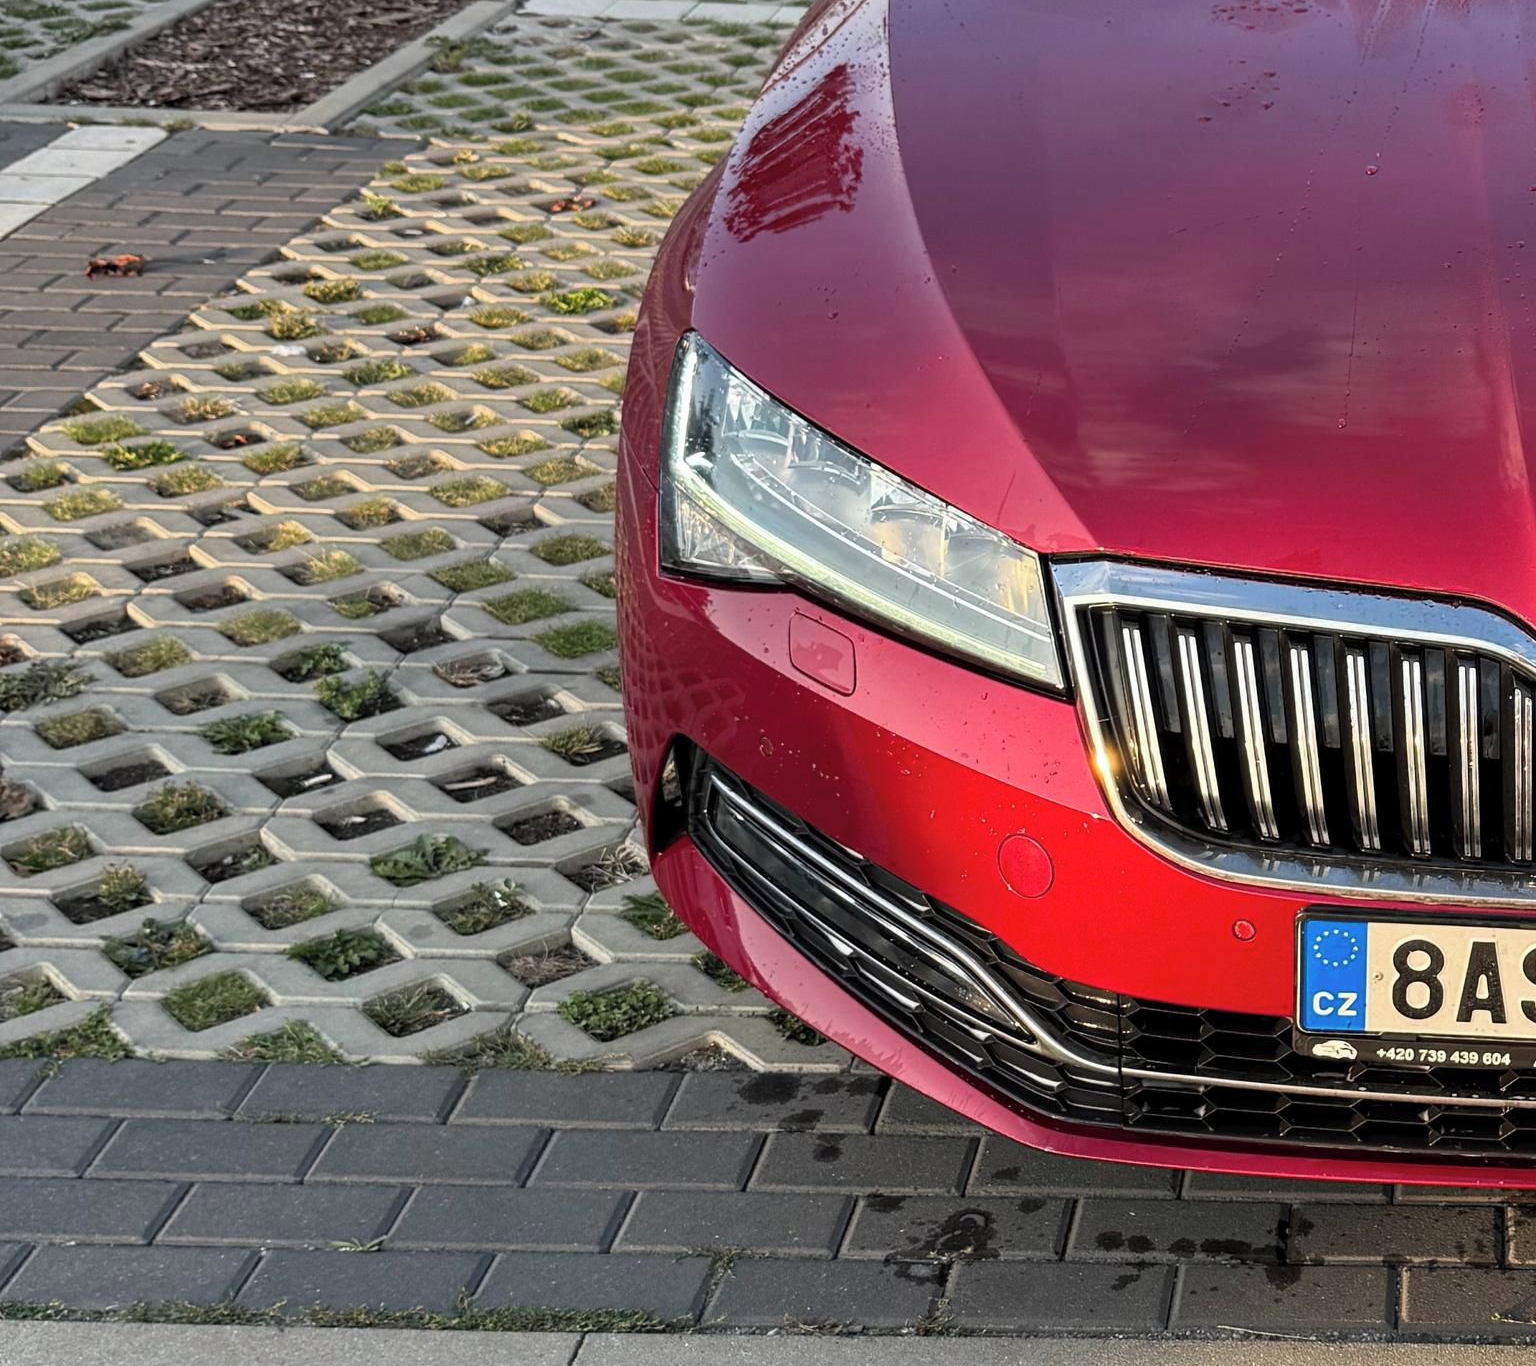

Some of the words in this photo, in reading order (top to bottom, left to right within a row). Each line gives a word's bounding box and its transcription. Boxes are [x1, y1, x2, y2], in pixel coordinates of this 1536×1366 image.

[1312, 991, 1357, 1016] CZ
[1376, 1047, 1414, 1061] +420
[1418, 1048, 1446, 1063] 739
[1450, 1050, 1478, 1064] 439
[1482, 1052, 1511, 1066] 604
